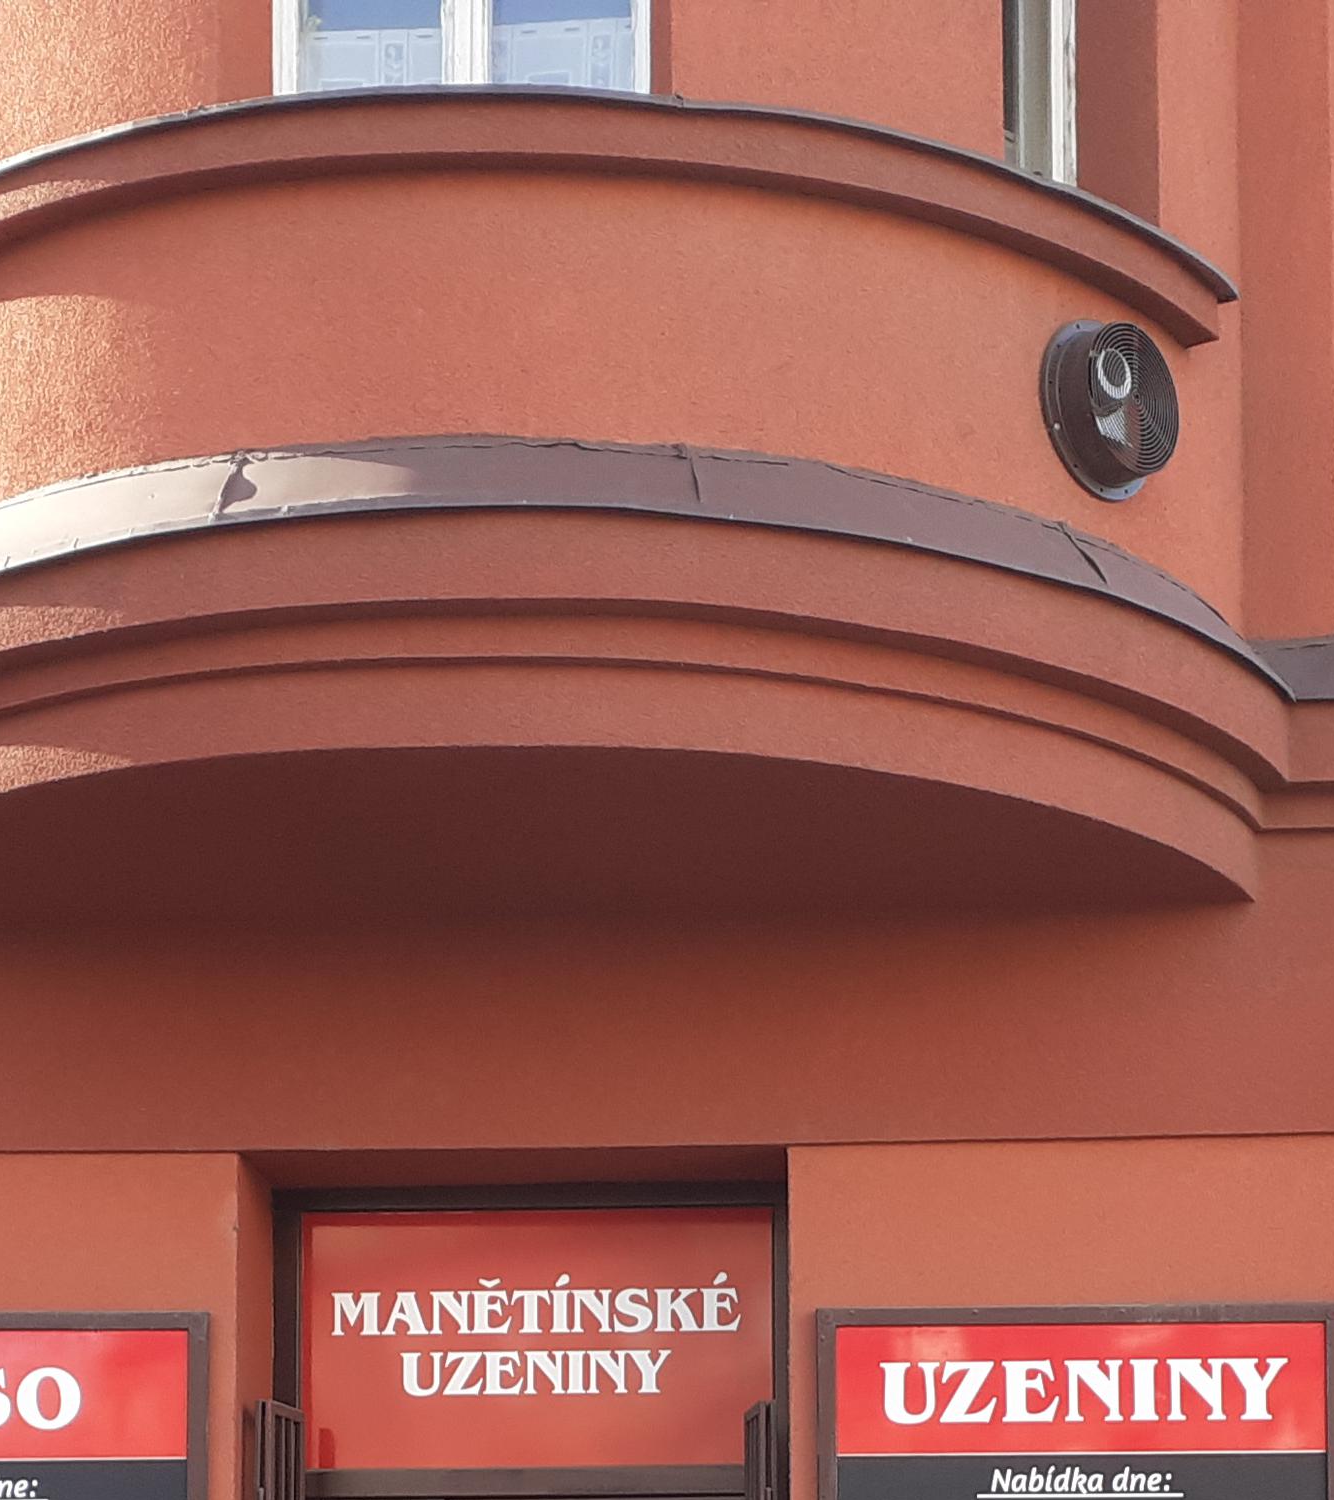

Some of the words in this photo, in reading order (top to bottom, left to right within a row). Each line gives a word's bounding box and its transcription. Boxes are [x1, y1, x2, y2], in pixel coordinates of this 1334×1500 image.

[331, 1271, 742, 1336] MANĚTÍNSKÉ
[400, 1349, 672, 1397] UZENINY
[879, 1357, 1289, 1425] UZENINY
[991, 1467, 1104, 1493] Nabídka
[1112, 1467, 1172, 1492] dne:
